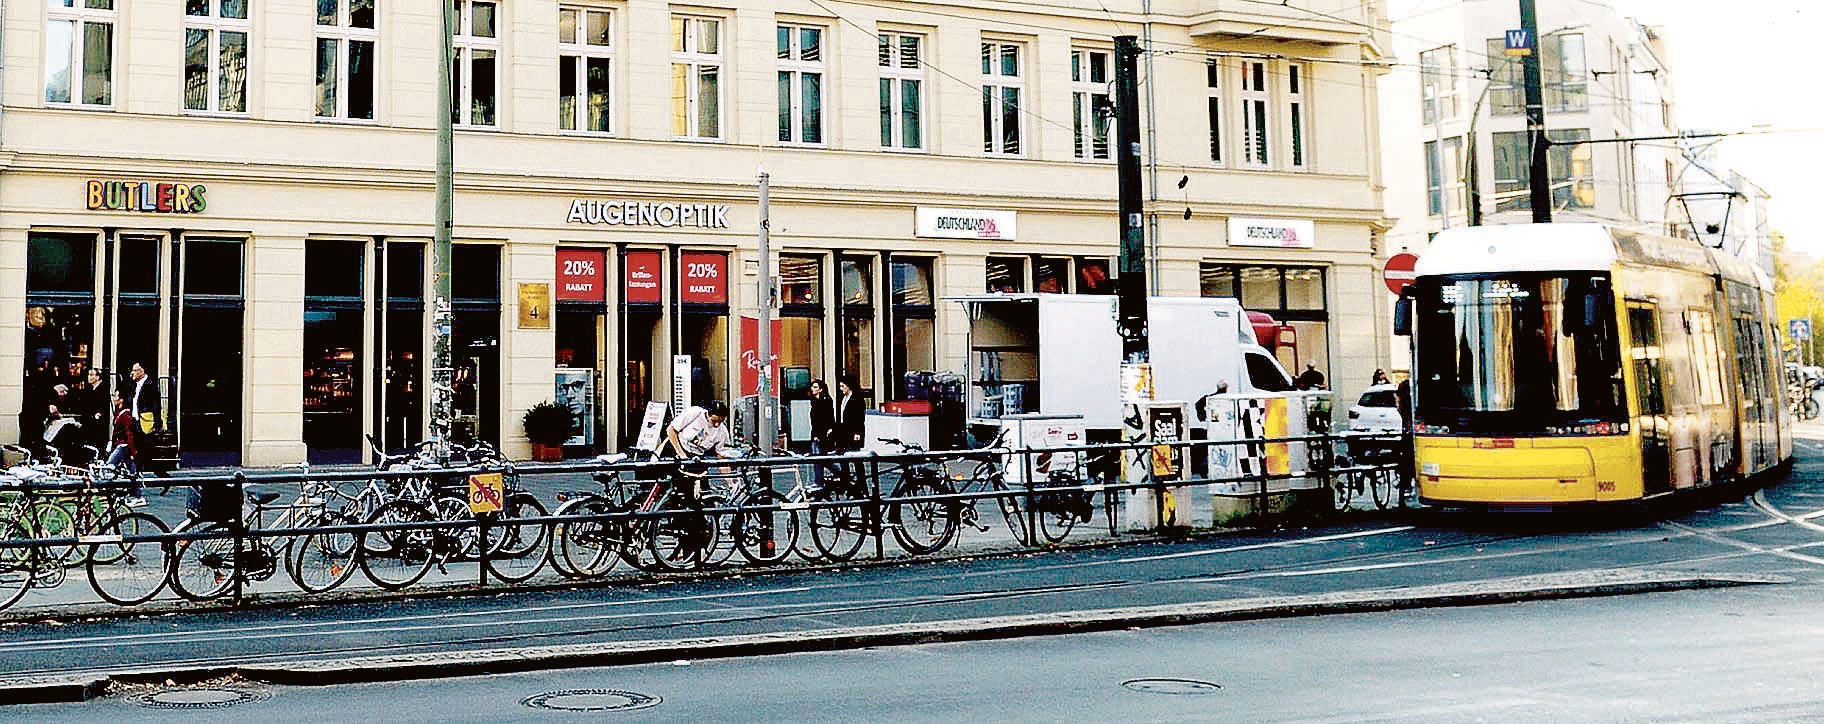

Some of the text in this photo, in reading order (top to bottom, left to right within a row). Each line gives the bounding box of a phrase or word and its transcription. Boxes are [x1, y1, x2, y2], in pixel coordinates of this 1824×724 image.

[1508, 31, 1527, 48] W
[87, 180, 206, 213] BUTLERS
[567, 199, 729, 229] AUGENOPTIK
[563, 260, 596, 276] 20%
[687, 263, 718, 279] 20%
[565, 283, 593, 292] RABATT
[689, 285, 716, 294] RABATT
[529, 305, 538, 320] 4
[1154, 418, 1177, 435] Saal
